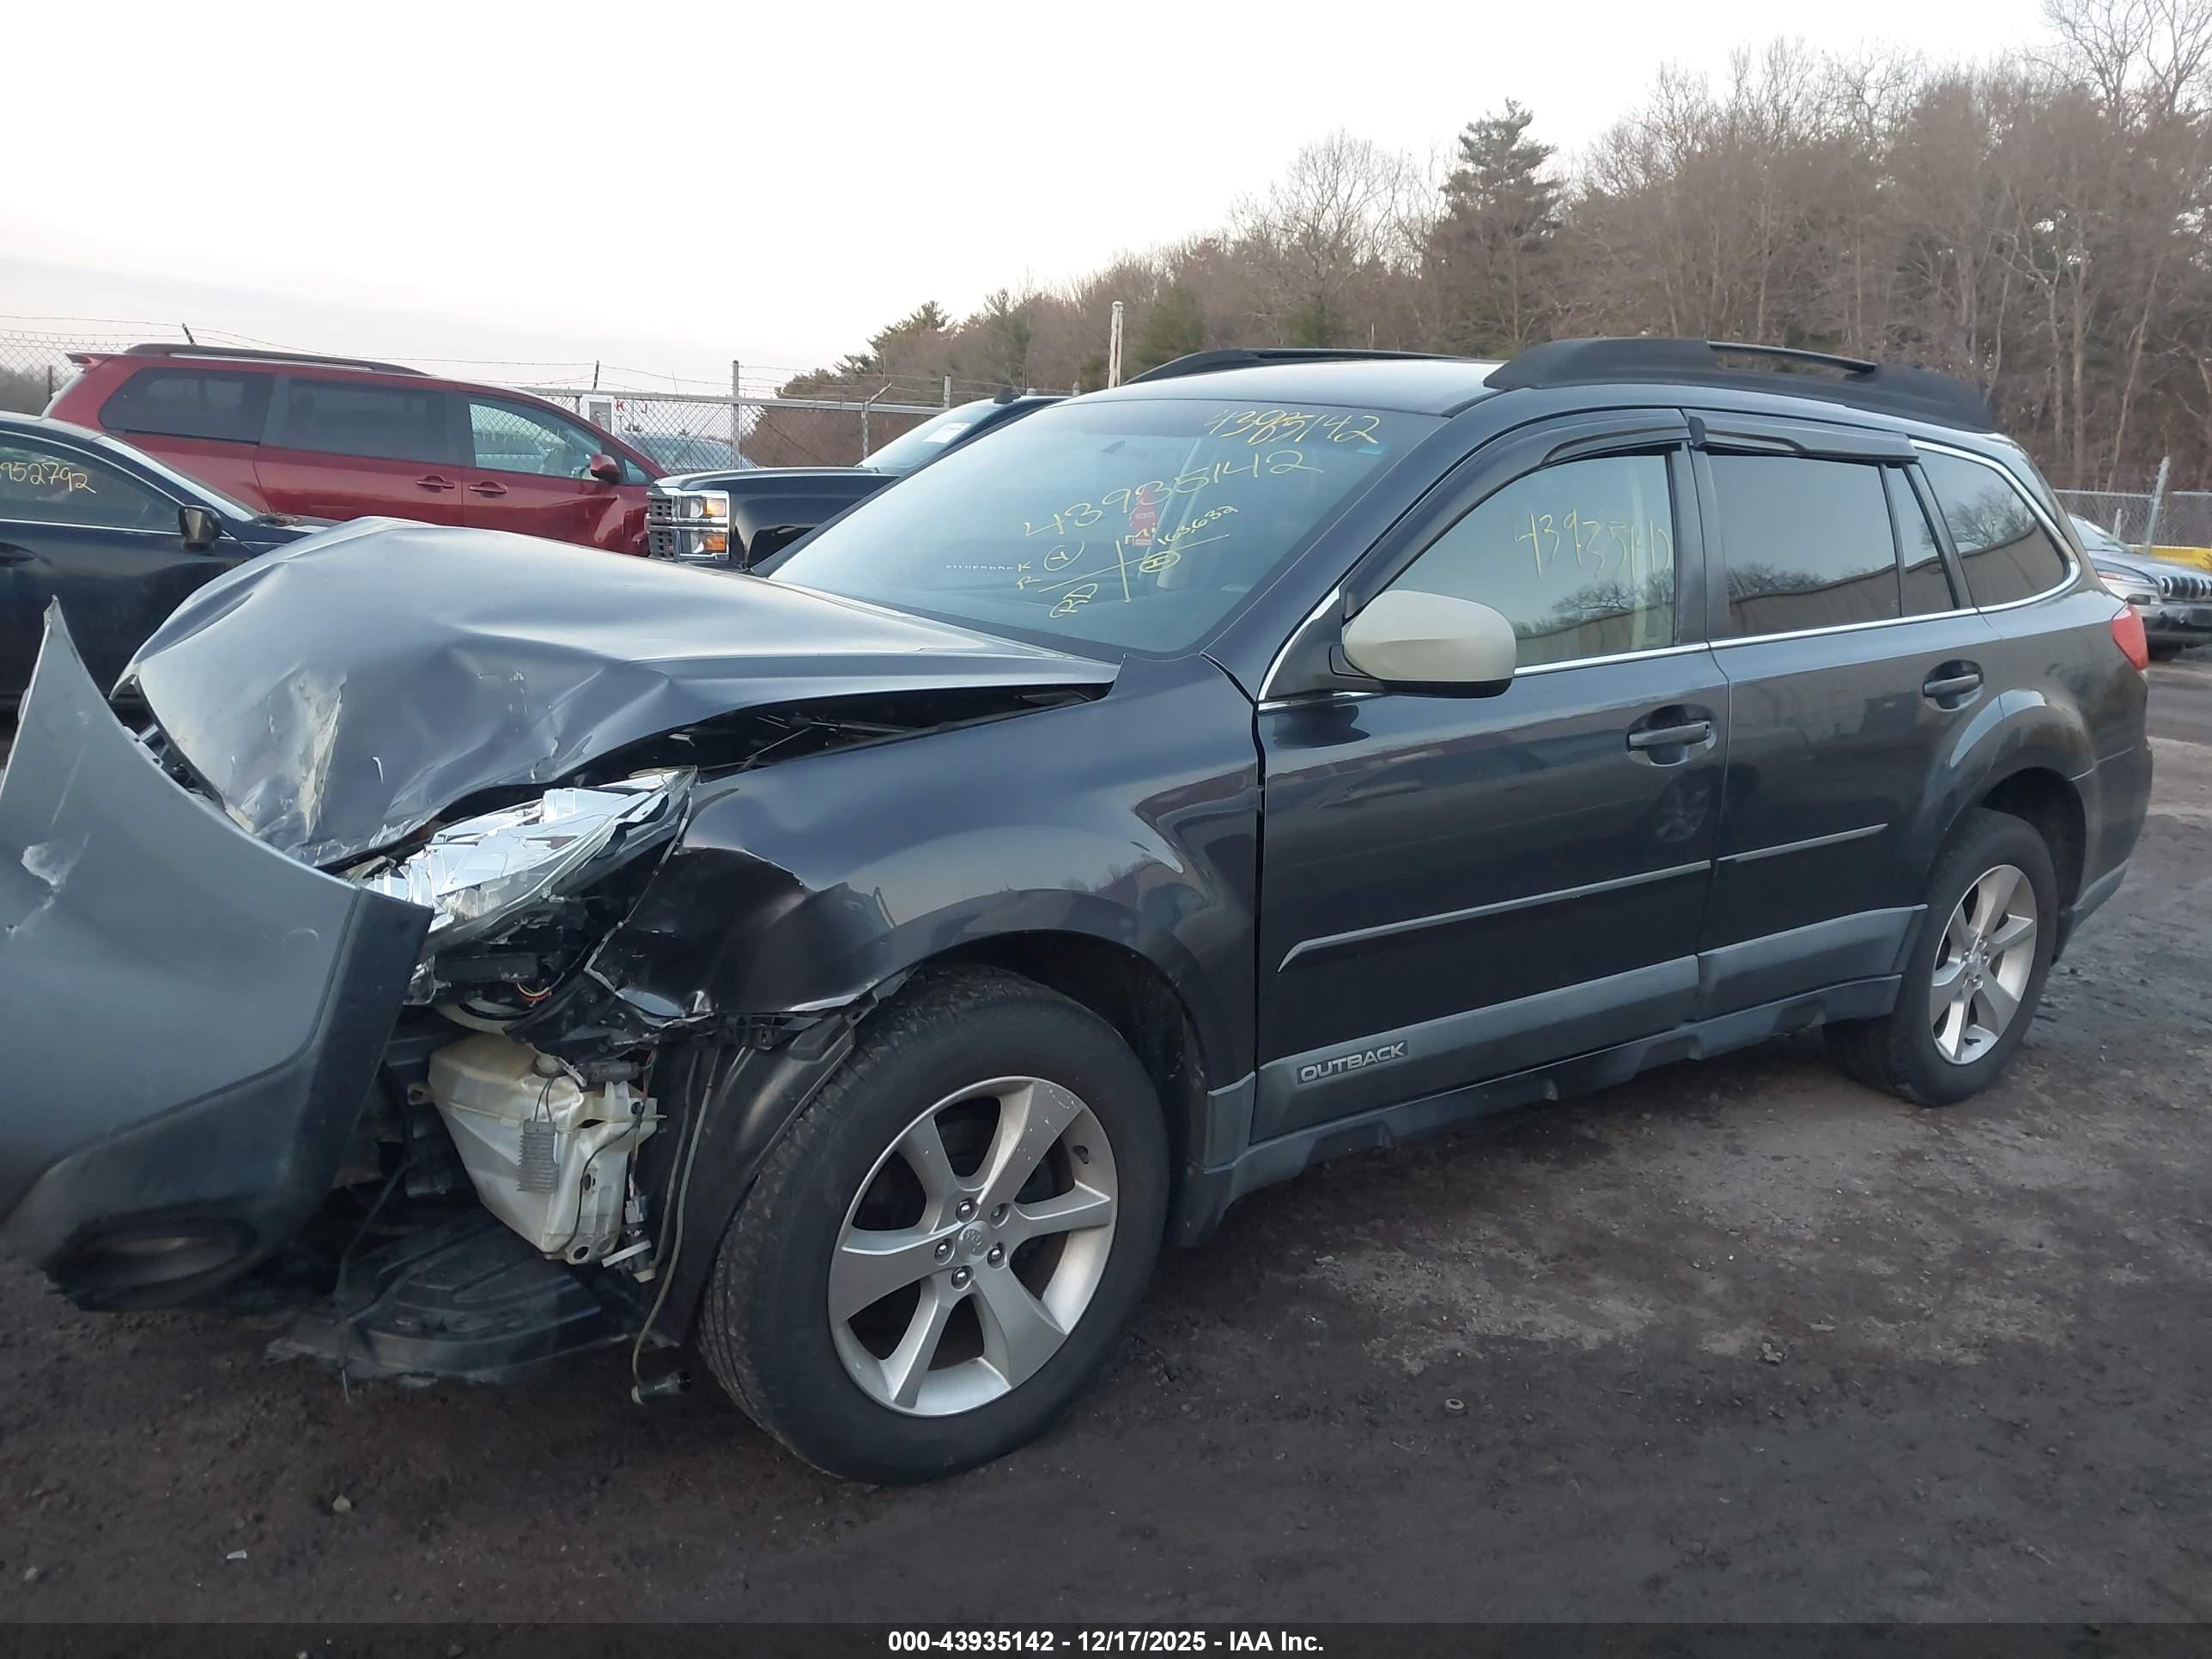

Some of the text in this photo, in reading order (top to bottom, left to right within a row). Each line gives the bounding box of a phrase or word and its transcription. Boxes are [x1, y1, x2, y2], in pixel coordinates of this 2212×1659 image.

[0, 461, 97, 494] 952792
[1024, 449, 1324, 537] 43935142
[1300, 1042, 1406, 1083] OUTBACK
